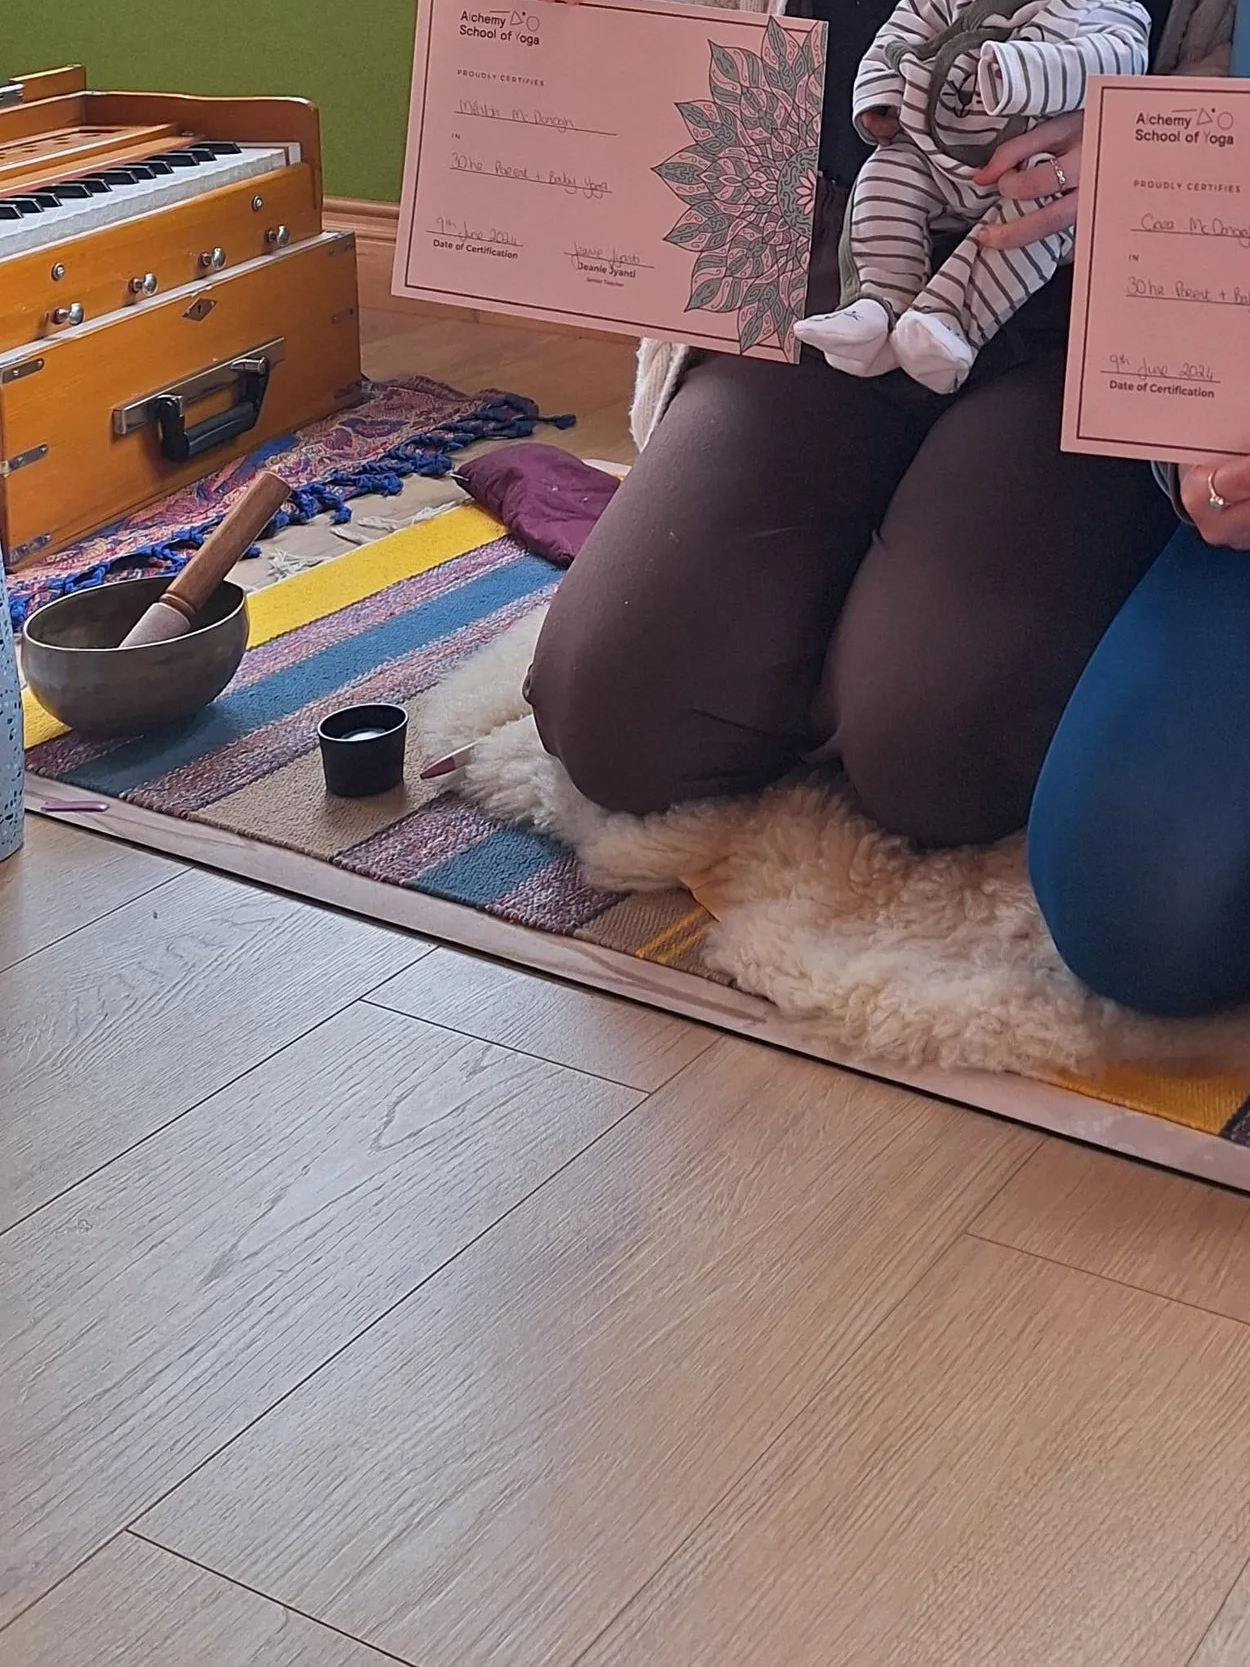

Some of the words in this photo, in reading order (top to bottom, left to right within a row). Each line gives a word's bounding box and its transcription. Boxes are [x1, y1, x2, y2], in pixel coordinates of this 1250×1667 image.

[460, 10, 507, 28] Alchemy
[459, 24, 497, 39] School
[500, 31, 512, 41] of
[515, 32, 540, 46] Yoga
[457, 69, 497, 80] PROUDLY
[500, 74, 544, 87] CERTIFIES
[1136, 112, 1192, 130] Alchemy
[1135, 128, 1181, 142] School
[1184, 131, 1199, 143] of
[1203, 131, 1234, 147] Yoga
[1133, 179, 1182, 190] PROUDLY
[1186, 182, 1241, 193] CERTIFIES
[433, 239, 453, 249] Date
[466, 244, 519, 259] Certification
[1128, 254, 1139, 262] IN
[577, 262, 608, 274] Jeanie
[1109, 354, 1130, 374] 9th
[1137, 357, 1168, 381] June
[1180, 362, 1214, 382] 2024
[1109, 380, 1135, 391] Date
[1136, 383, 1148, 392] of
[1149, 383, 1215, 399] Certification
